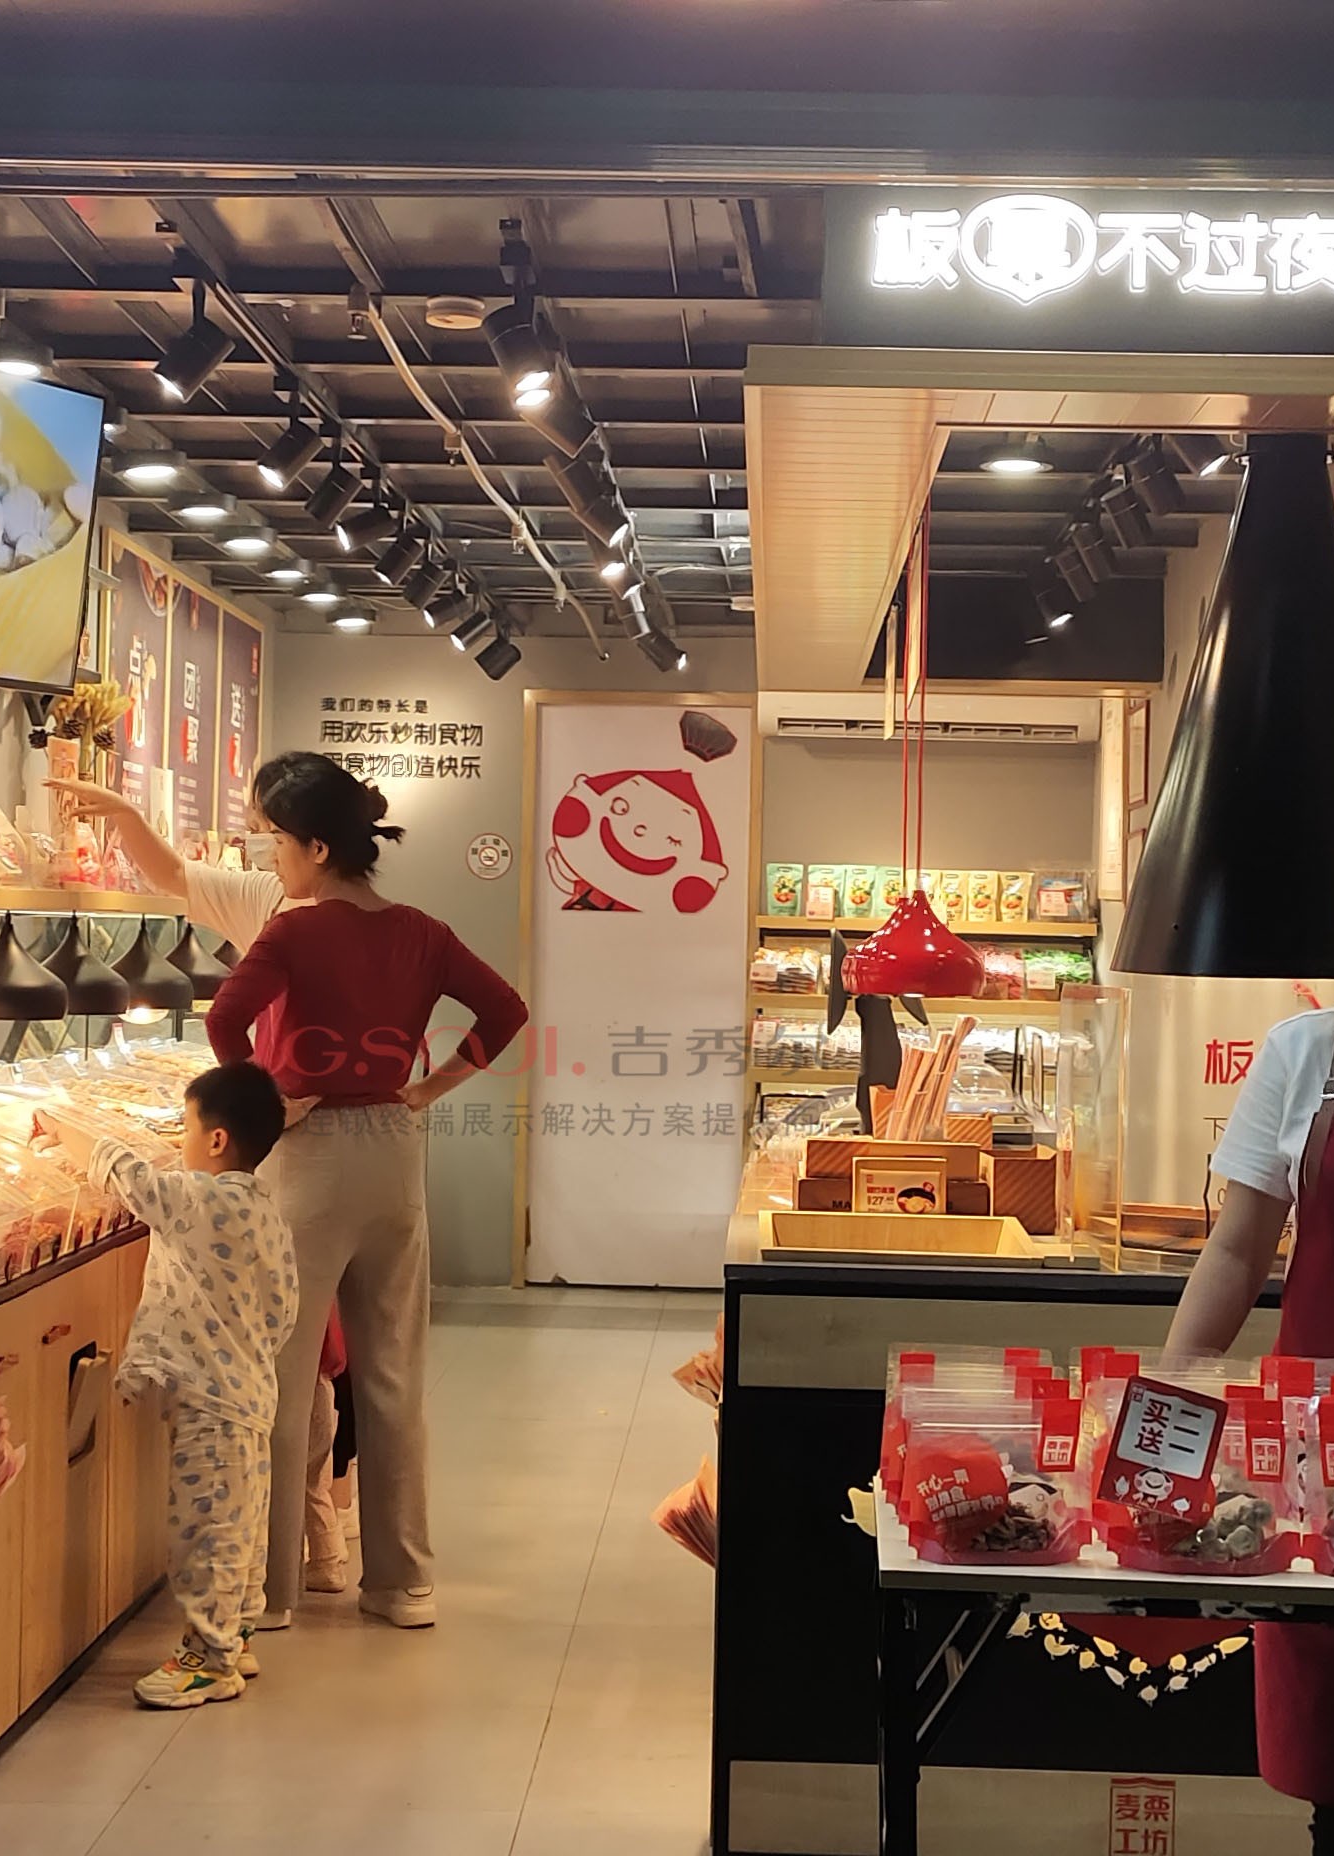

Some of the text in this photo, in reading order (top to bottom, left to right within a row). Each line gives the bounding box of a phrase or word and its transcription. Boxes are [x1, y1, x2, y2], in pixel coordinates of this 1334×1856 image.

[321, 697, 428, 714] 我们的特长是
[320, 720, 483, 747] 用欢乐炒制食物
[1203, 1039, 1254, 1084] 板
[1115, 1794, 1170, 1821] 麦栗
[1114, 1828, 1168, 1856] 工坊
